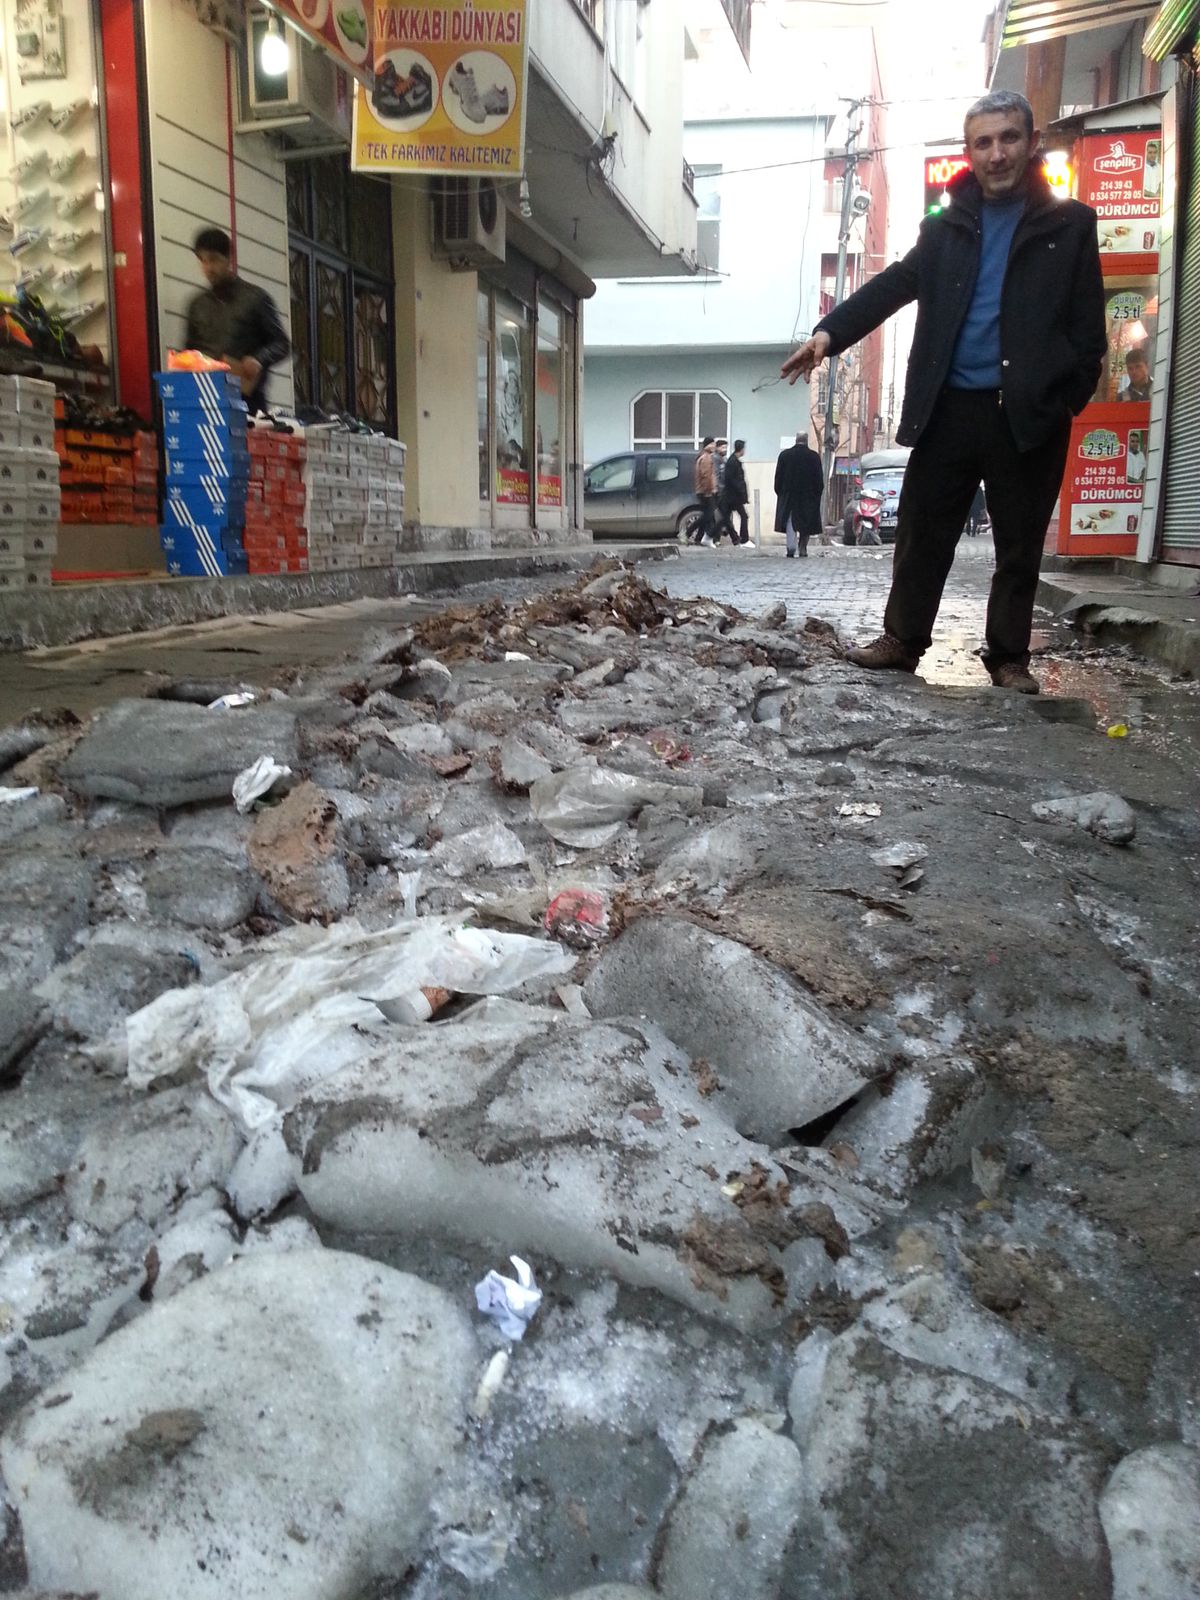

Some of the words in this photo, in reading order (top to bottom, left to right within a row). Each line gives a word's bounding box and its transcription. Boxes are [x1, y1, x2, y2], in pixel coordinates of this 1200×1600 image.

[374, 7, 447, 41] YAKKABI
[451, 2, 521, 43] DÜNYASI
[391, 143, 447, 162] FARKIMIZ
[1100, 157, 1136, 170] şenpiliç
[1101, 181, 1113, 190] 214
[1114, 181, 1123, 189] 39
[1124, 181, 1132, 189] 43
[1090, 192, 1094, 200] 0
[1096, 191, 1109, 201] 534
[1110, 191, 1122, 200] 577
[1133, 191, 1141, 199] 05
[1096, 202, 1158, 216] DÜRÜMCÜ
[1114, 306, 1129, 319] 2.5
[1085, 467, 1097, 475] 214
[1099, 467, 1106, 475] 39
[1075, 477, 1080, 485] 0
[1081, 477, 1093, 485] 534
[1094, 476, 1106, 485] 577
[1107, 476, 1115, 484] 29
[1116, 476, 1124, 484] 05
[1081, 488, 1142, 500] DÜRÜMCÜ
